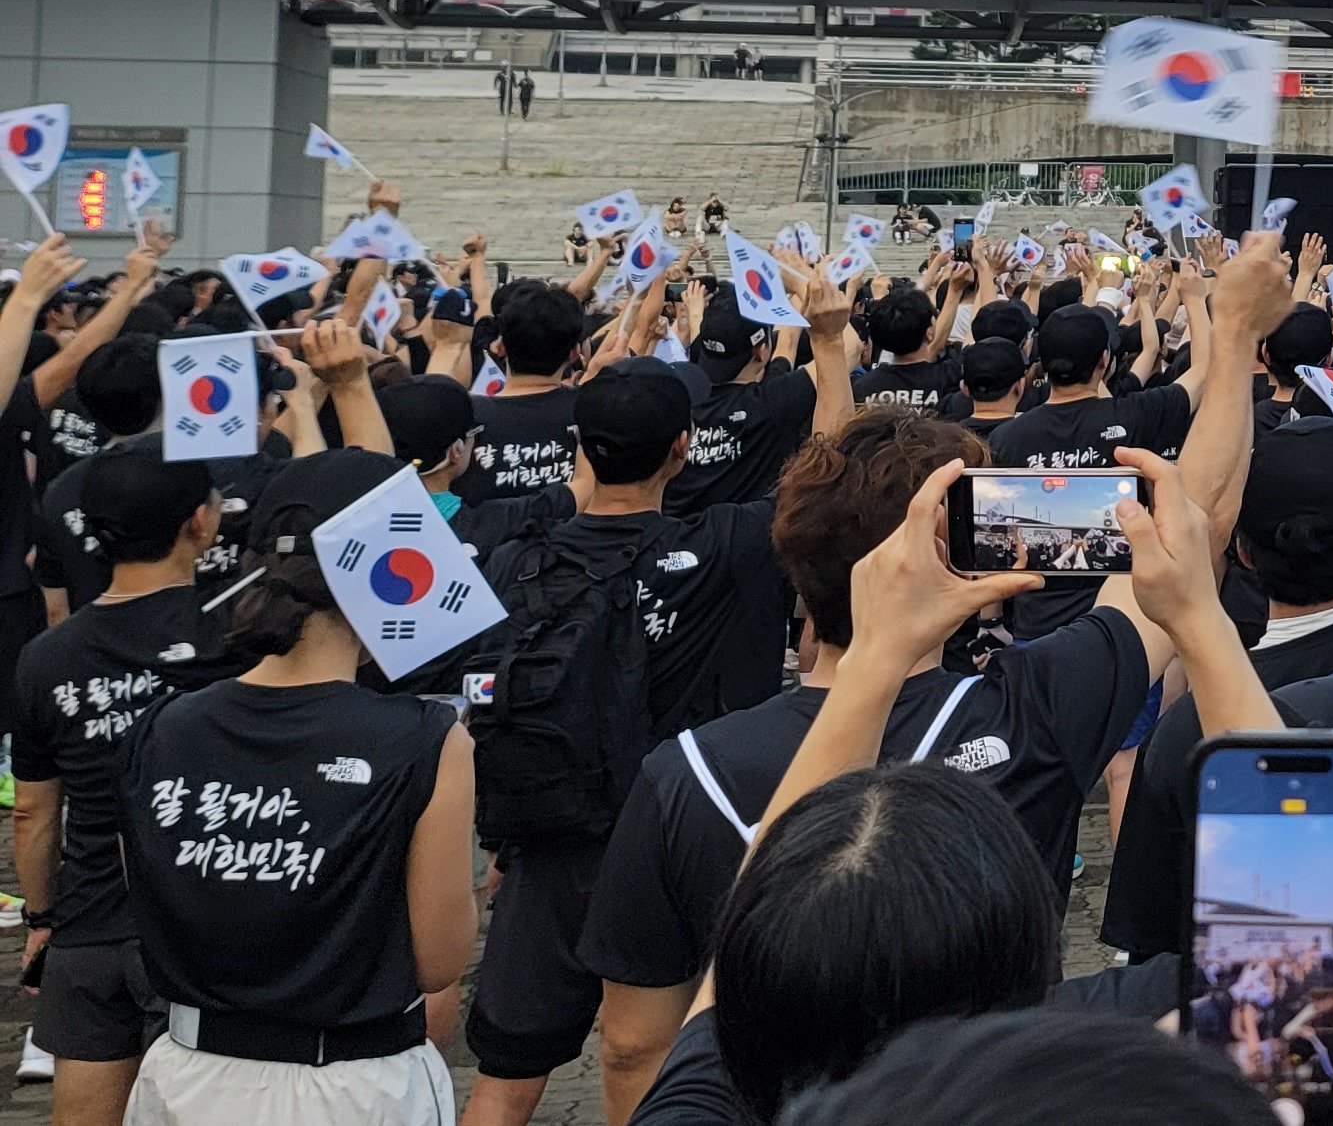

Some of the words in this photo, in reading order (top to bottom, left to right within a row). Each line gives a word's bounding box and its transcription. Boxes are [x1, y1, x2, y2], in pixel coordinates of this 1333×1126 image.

[474, 444, 499, 470] 잘
[502, 440, 573, 464] 될거야,
[1051, 446, 1107, 469] 될거야,
[52, 680, 82, 717] 잘
[86, 669, 176, 713] 될거야,
[943, 748, 988, 768] NORTH
[959, 737, 985, 754] THE
[956, 758, 989, 774] FACE
[151, 776, 192, 828] 잘
[195, 780, 311, 835] 될거야,
[175, 833, 326, 892] 대한민국!
